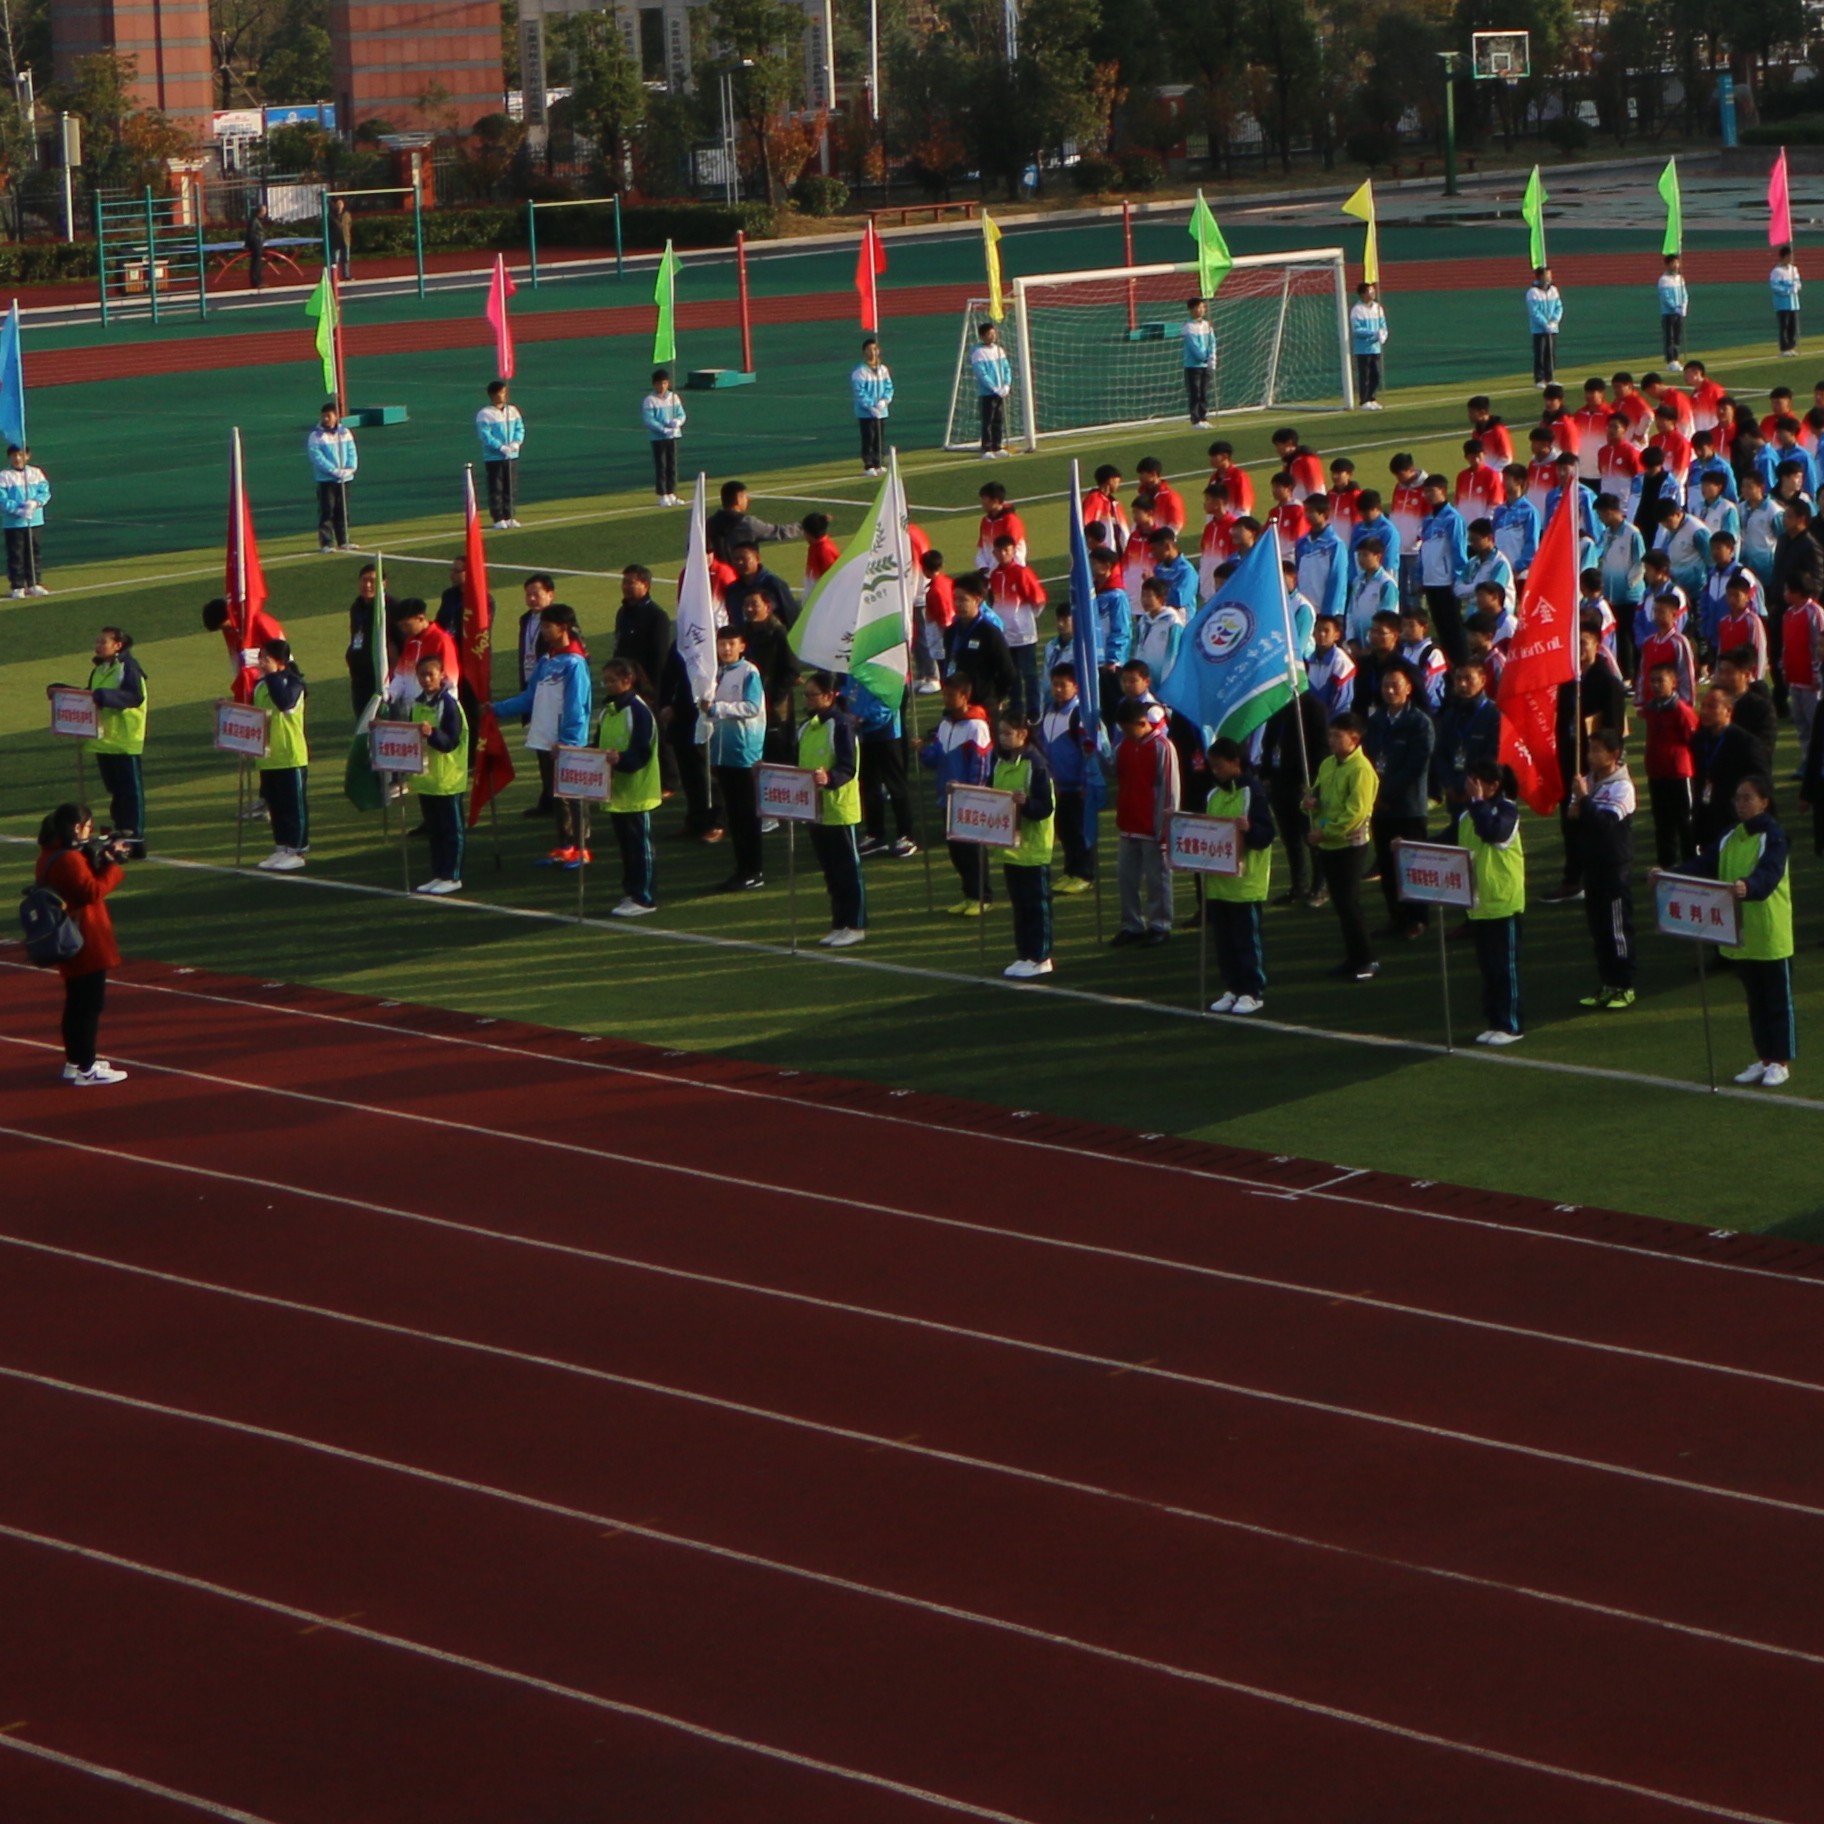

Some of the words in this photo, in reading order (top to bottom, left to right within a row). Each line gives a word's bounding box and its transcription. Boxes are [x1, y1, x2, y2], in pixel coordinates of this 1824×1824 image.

[1176, 836, 1234, 860] 天堂寨中心小学
